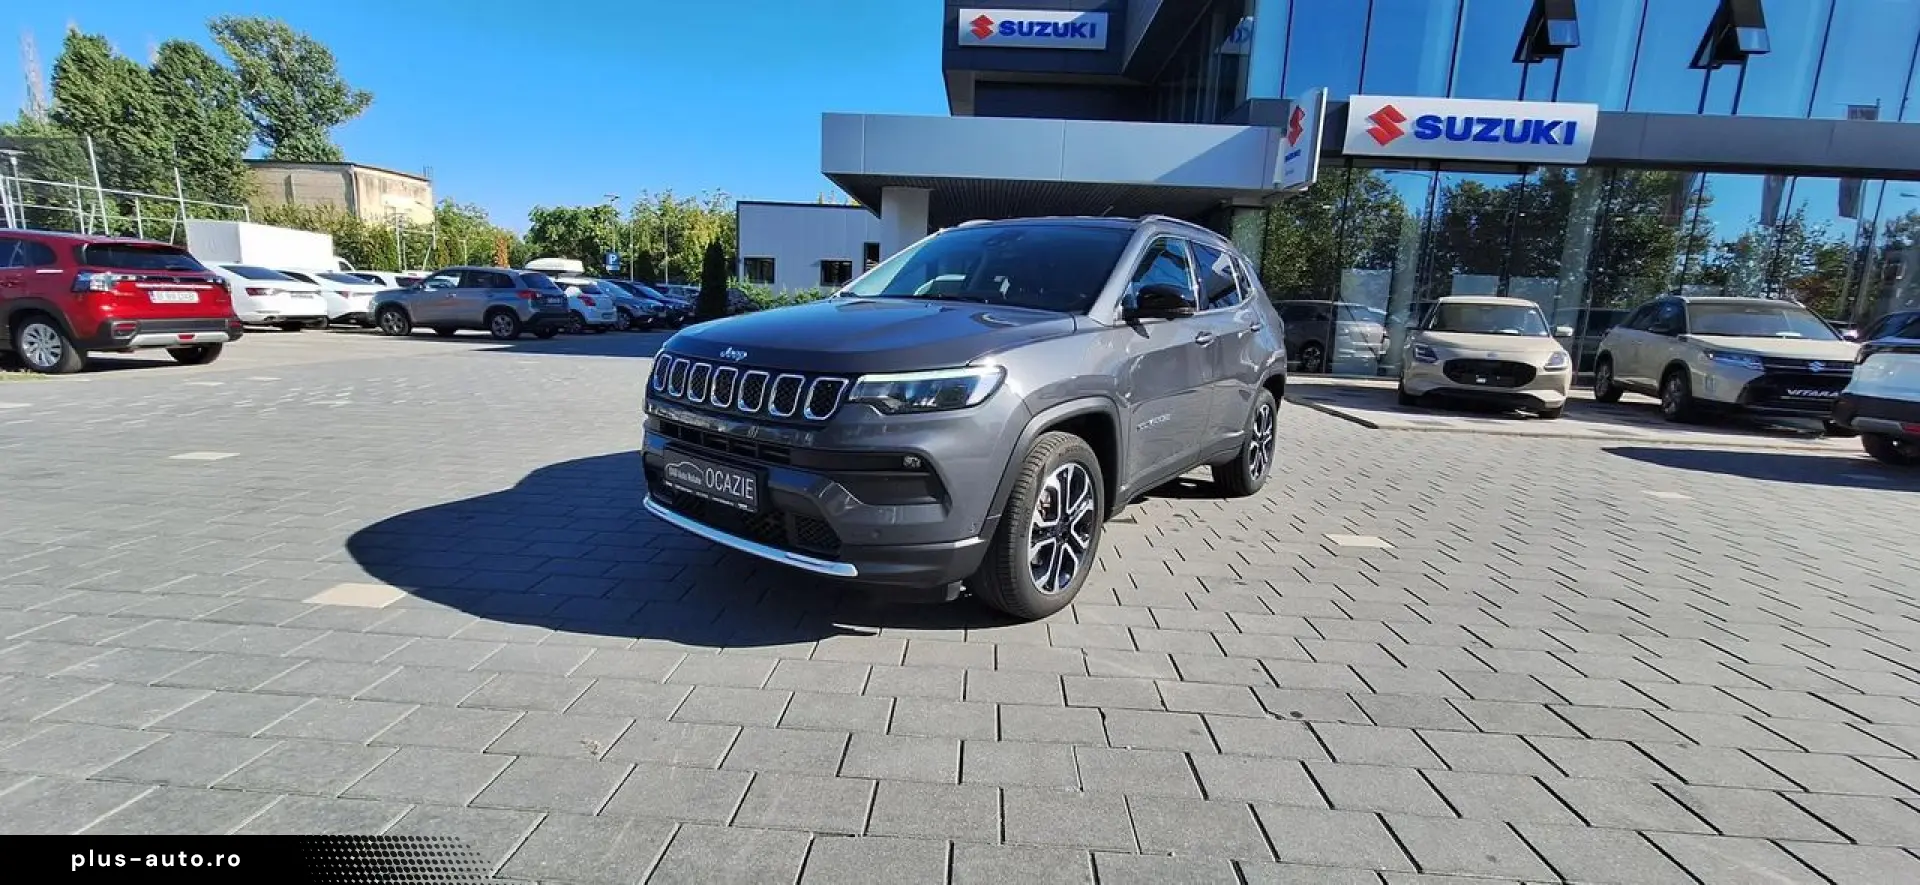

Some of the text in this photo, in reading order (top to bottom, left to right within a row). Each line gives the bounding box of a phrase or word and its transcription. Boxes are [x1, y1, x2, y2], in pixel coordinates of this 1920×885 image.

[999, 20, 1097, 39] SUZUKI
[1414, 114, 1578, 146] SUZUKI
[609, 254, 618, 265] P
[1787, 389, 1840, 397] VITARA
[705, 467, 754, 500] OCAZIE
